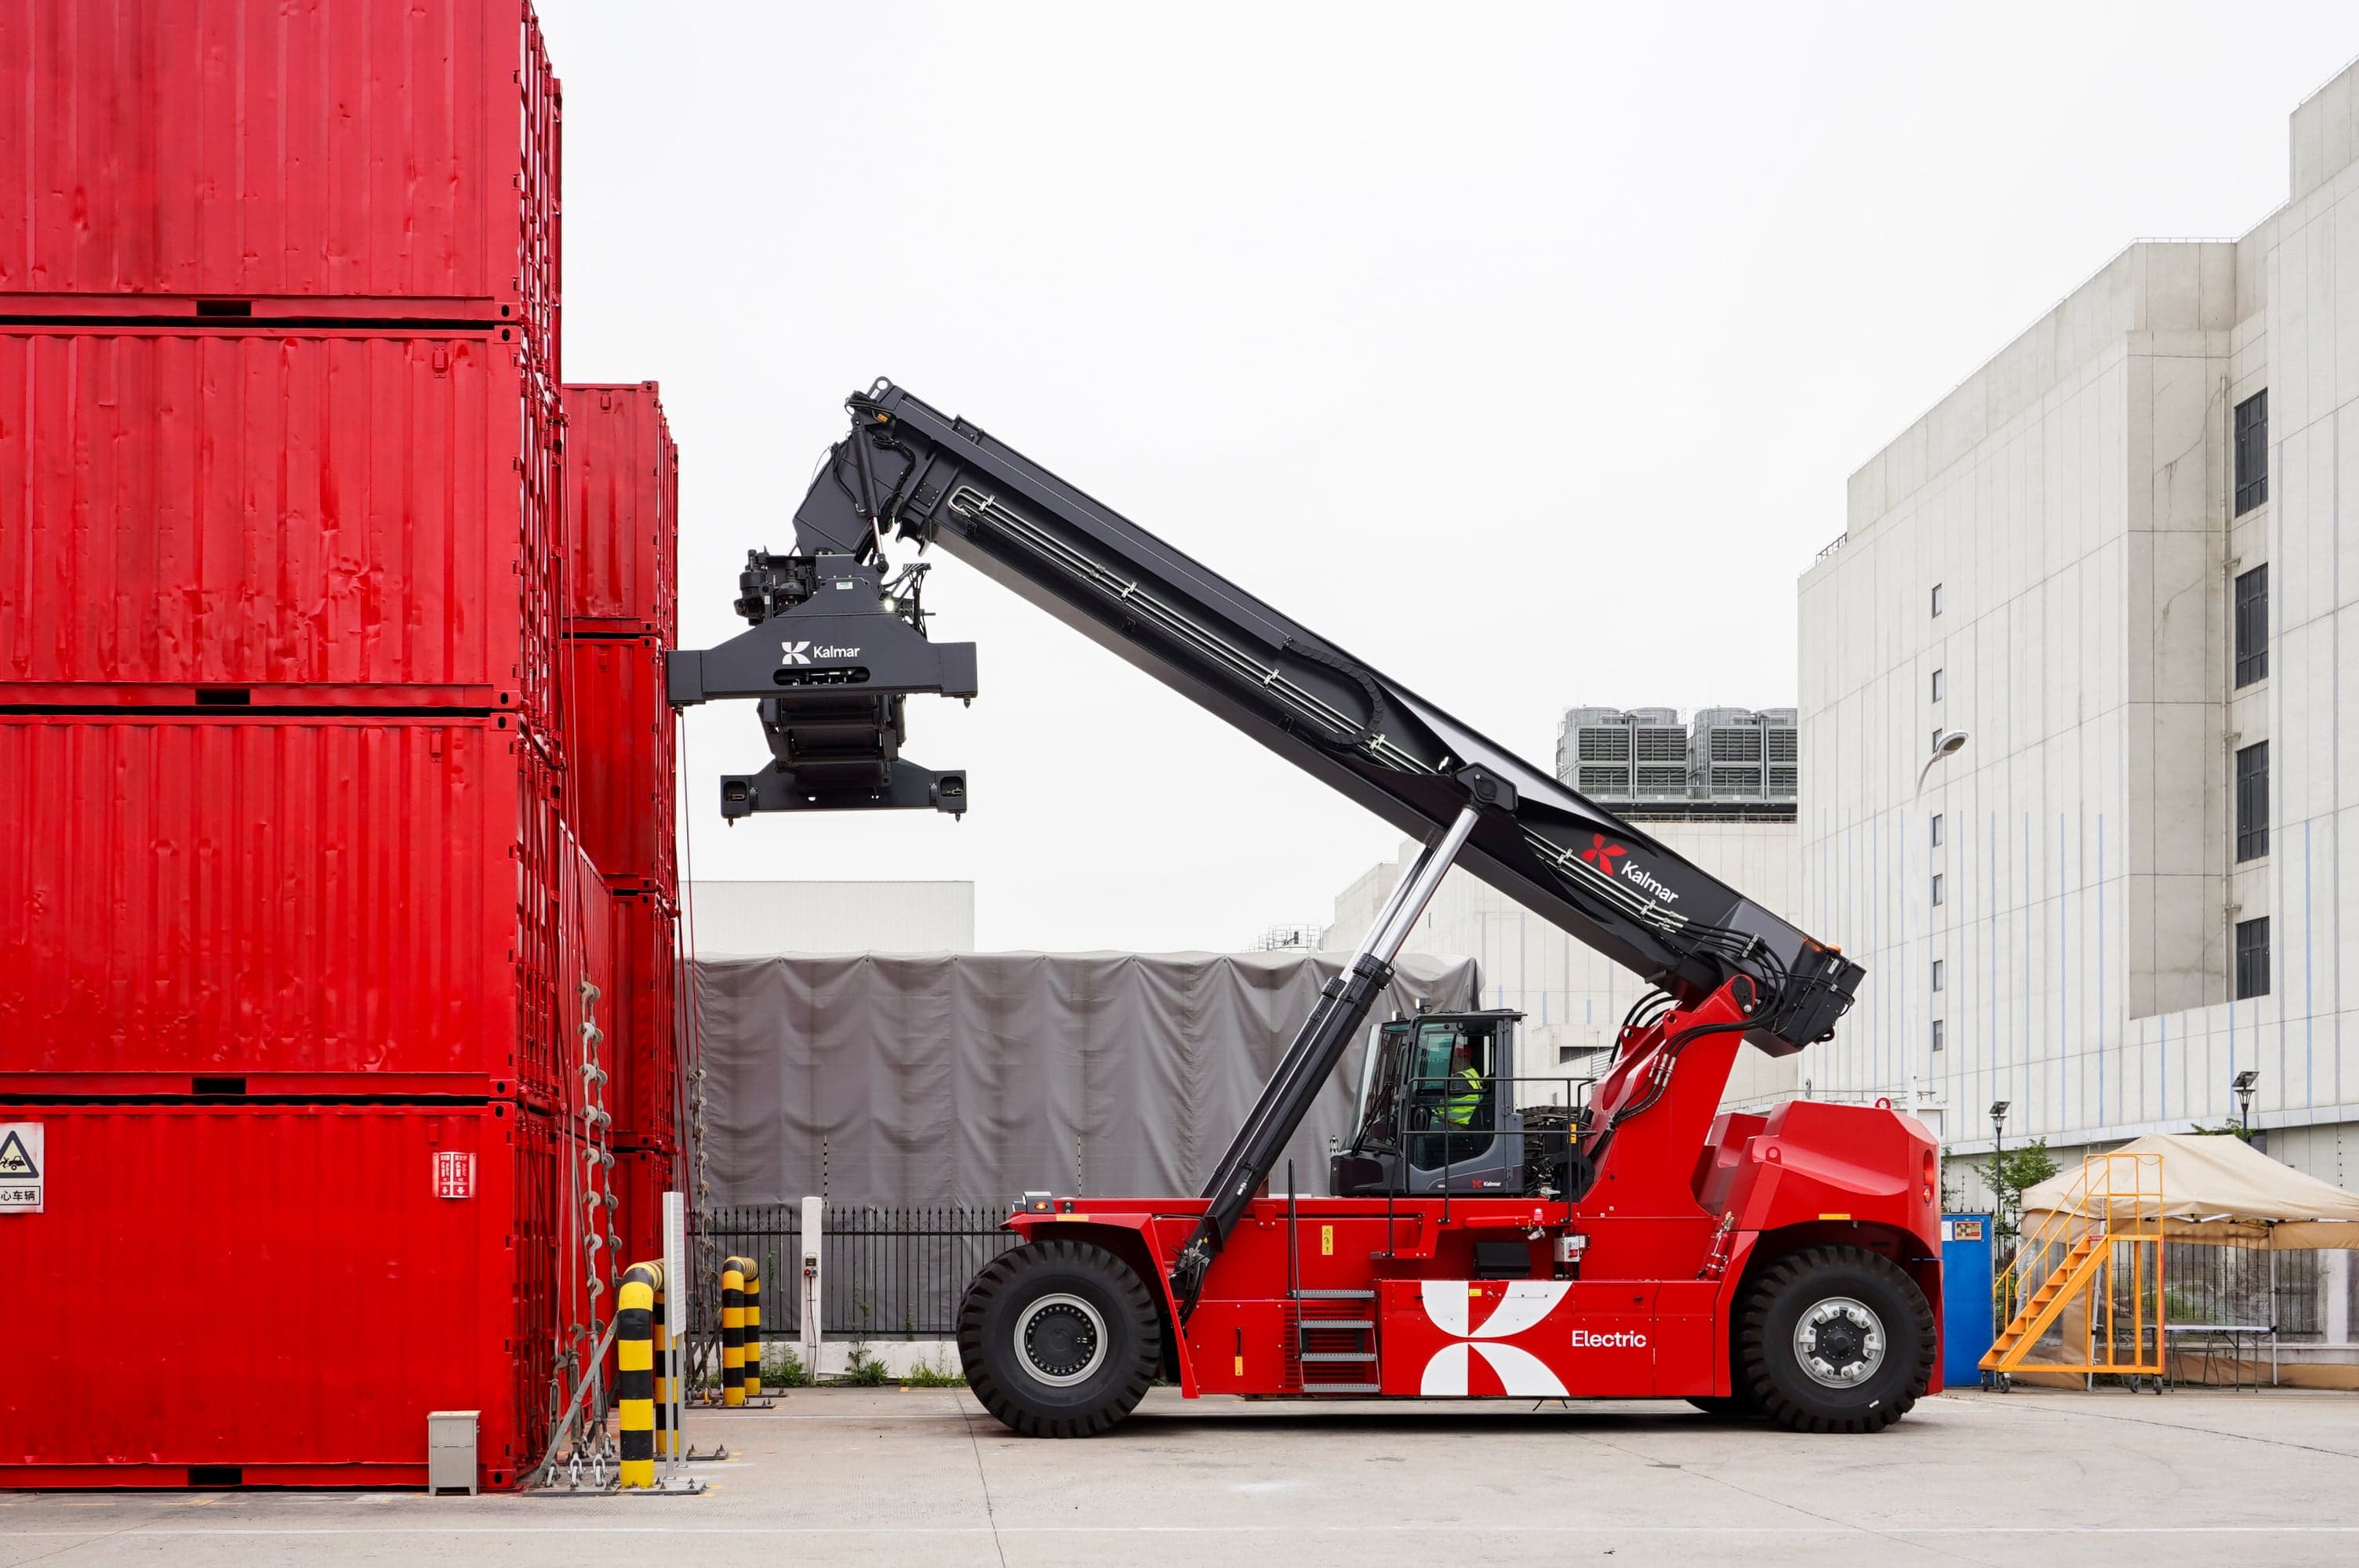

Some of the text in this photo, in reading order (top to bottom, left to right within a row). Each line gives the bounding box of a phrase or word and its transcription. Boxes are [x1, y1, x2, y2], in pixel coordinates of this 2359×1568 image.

[813, 645, 860, 659] Kalmar
[1621, 860, 1679, 903] Kalmar
[1572, 1330, 1647, 1348] Electric
